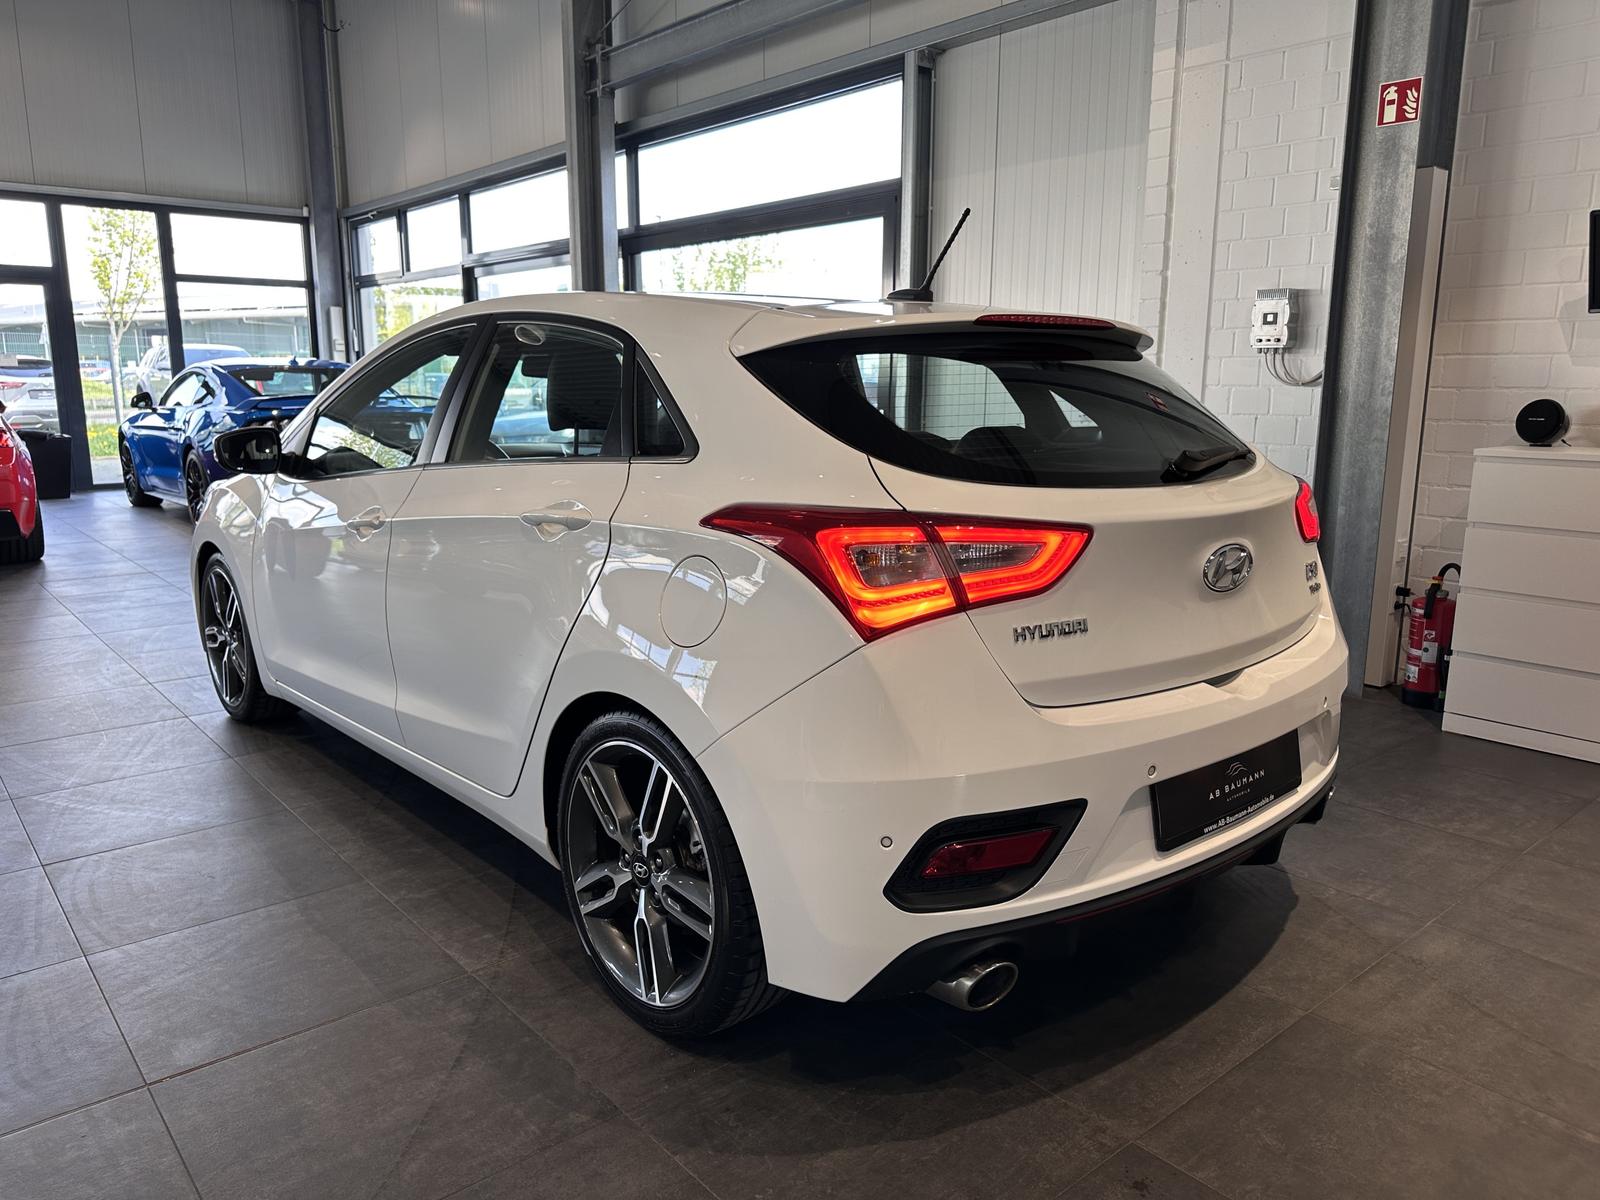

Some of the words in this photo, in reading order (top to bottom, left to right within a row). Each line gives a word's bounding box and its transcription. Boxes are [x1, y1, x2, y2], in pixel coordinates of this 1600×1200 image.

[1012, 618, 1088, 642] HYUNDAI
[1209, 789, 1220, 800] AB
[1224, 769, 1265, 793] BAUMANN
